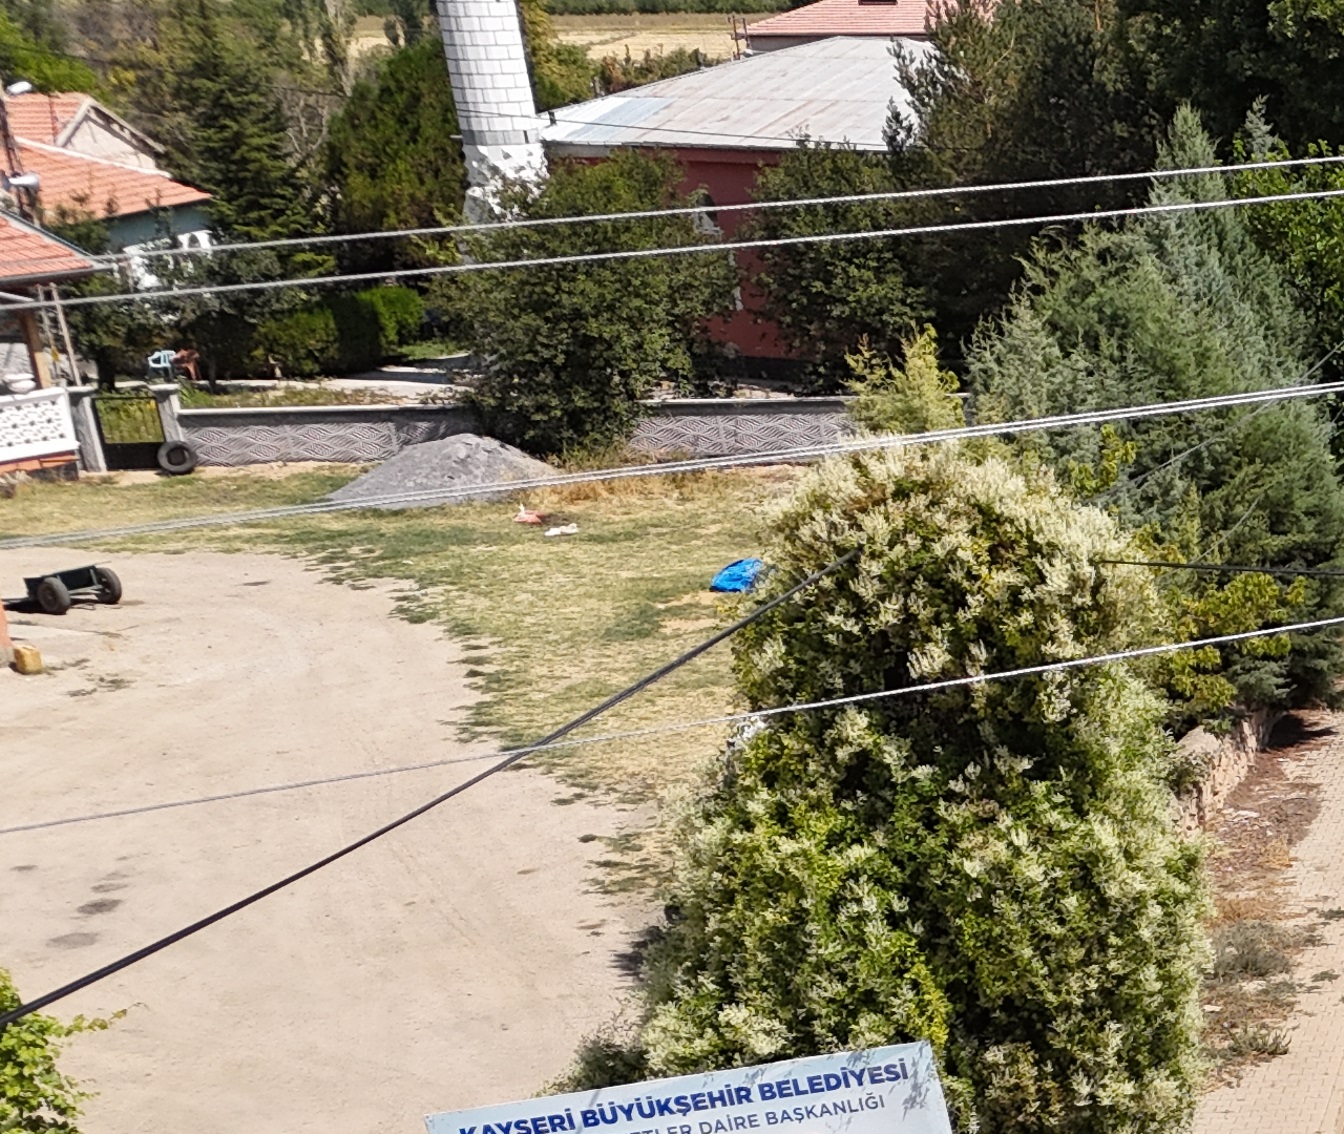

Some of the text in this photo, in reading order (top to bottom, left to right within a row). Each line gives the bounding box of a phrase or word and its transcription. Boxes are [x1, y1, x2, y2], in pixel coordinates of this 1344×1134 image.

[580, 1083, 753, 1129] BÜYÜKŞEHİR
[758, 1058, 909, 1102] BELEDİYESİ
[766, 1092, 885, 1126] BAŞKANLIĞI
